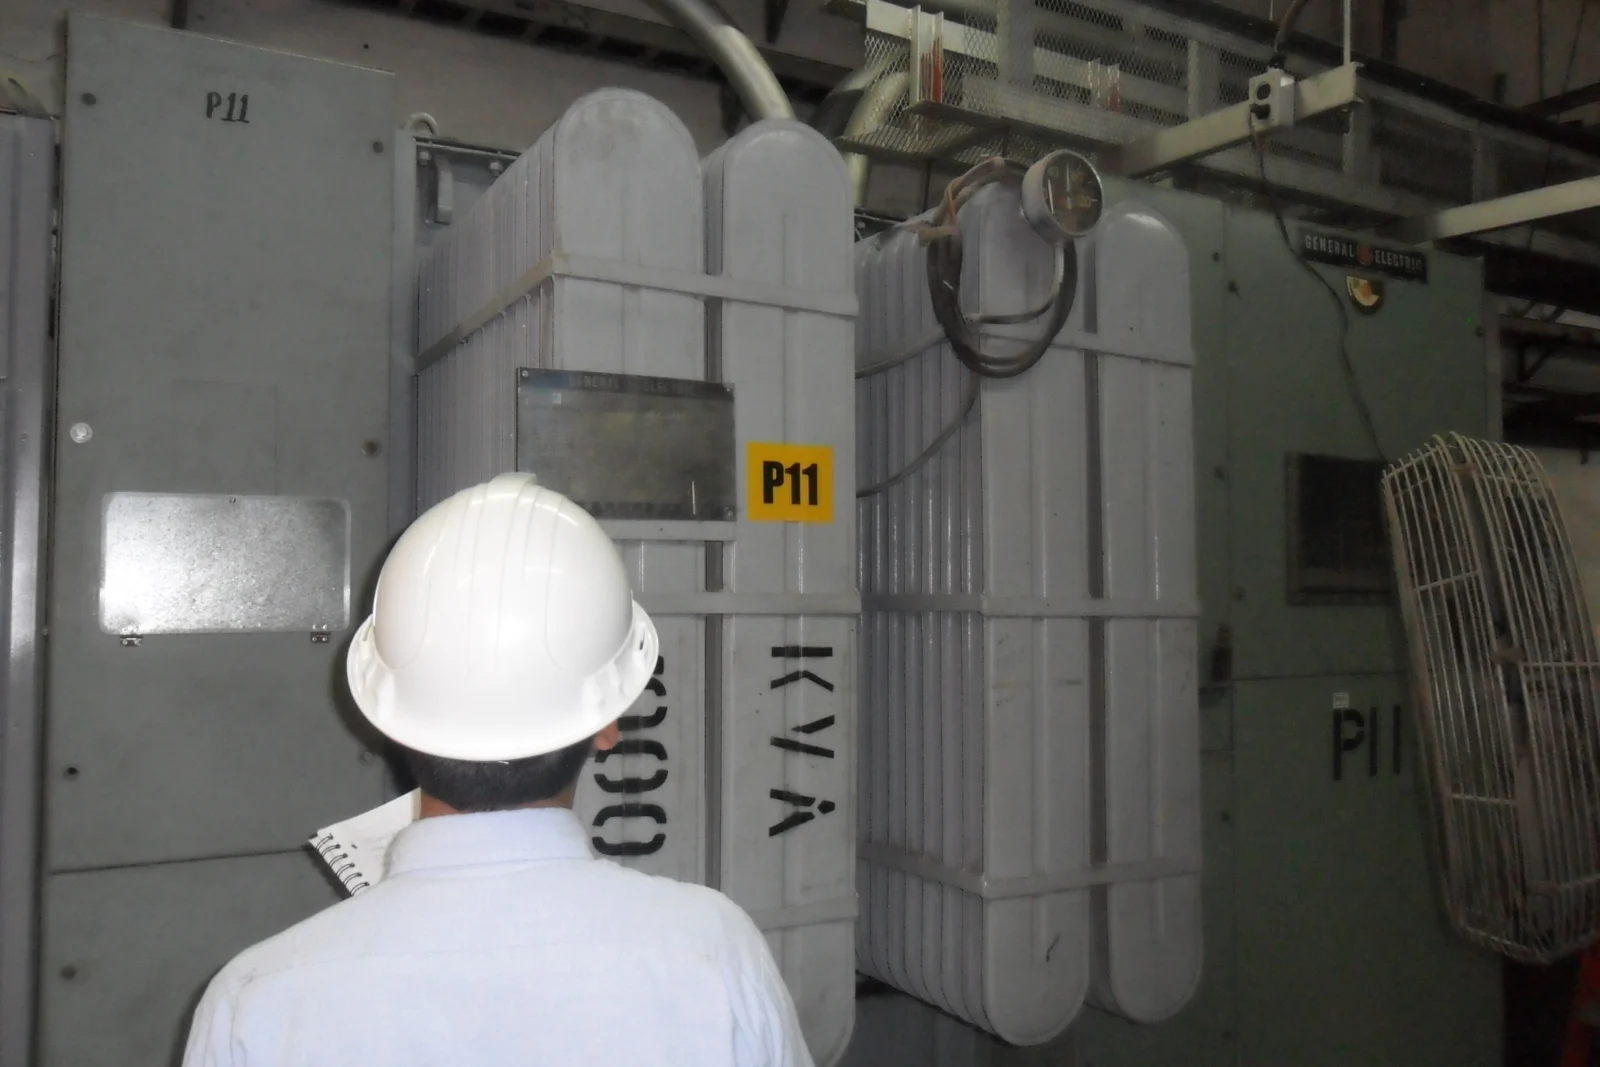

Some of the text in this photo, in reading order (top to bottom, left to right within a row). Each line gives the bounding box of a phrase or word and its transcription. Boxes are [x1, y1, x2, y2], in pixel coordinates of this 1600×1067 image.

[206, 91, 249, 123] P11
[1305, 234, 1422, 271] GENERAL ELECTRIC
[763, 460, 818, 505] P11
